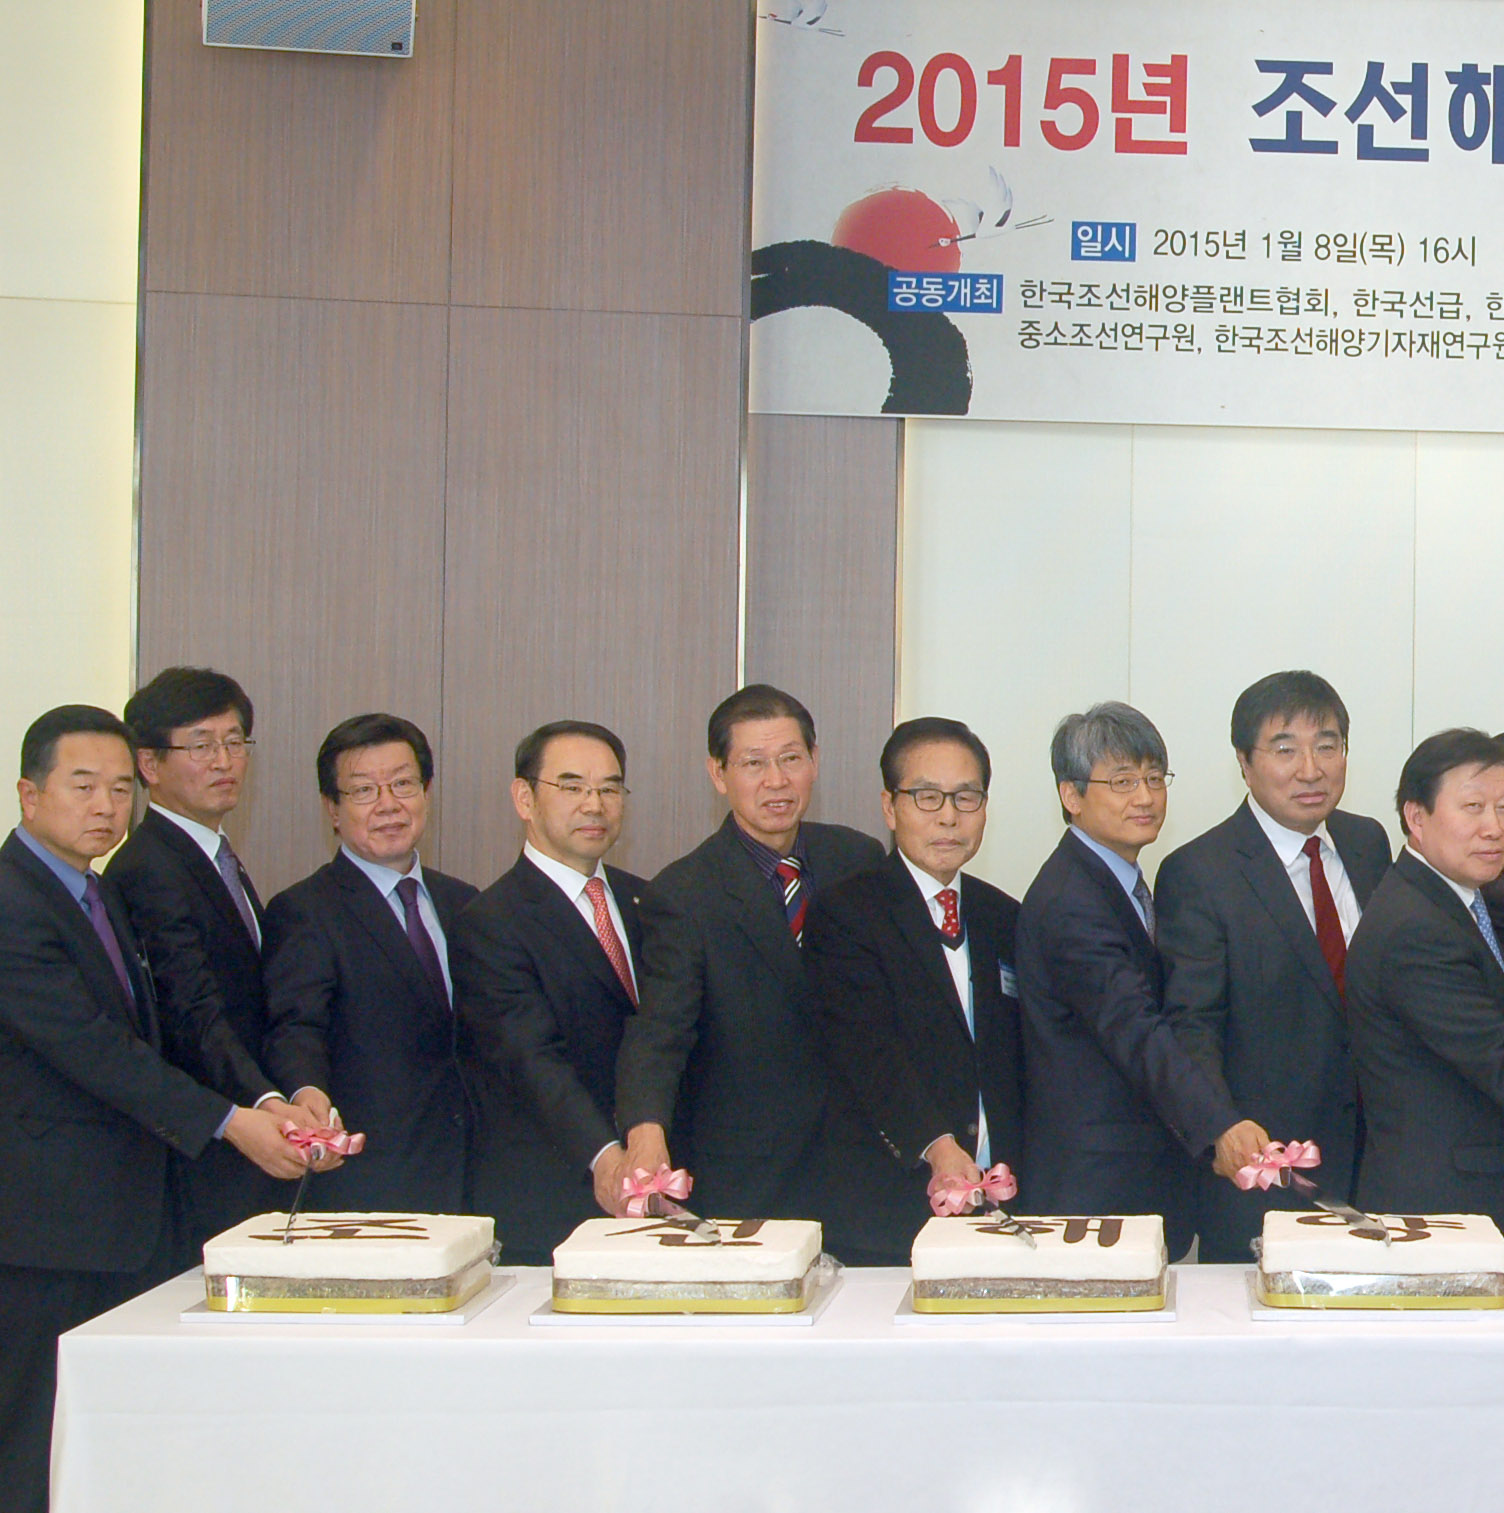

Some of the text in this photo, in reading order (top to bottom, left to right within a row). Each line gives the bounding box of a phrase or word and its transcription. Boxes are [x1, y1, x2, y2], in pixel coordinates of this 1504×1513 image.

[854, 51, 1187, 155] 2015년
[1078, 225, 1475, 266] 일시 2015년 1월 8일(목) 16시
[894, 278, 996, 307] 공동개최
[1020, 280, 1337, 317] 한국조선해양플랜트협회,
[1353, 289, 1470, 320] 한국선급,
[1018, 321, 1201, 354] 중소조선연구원,
